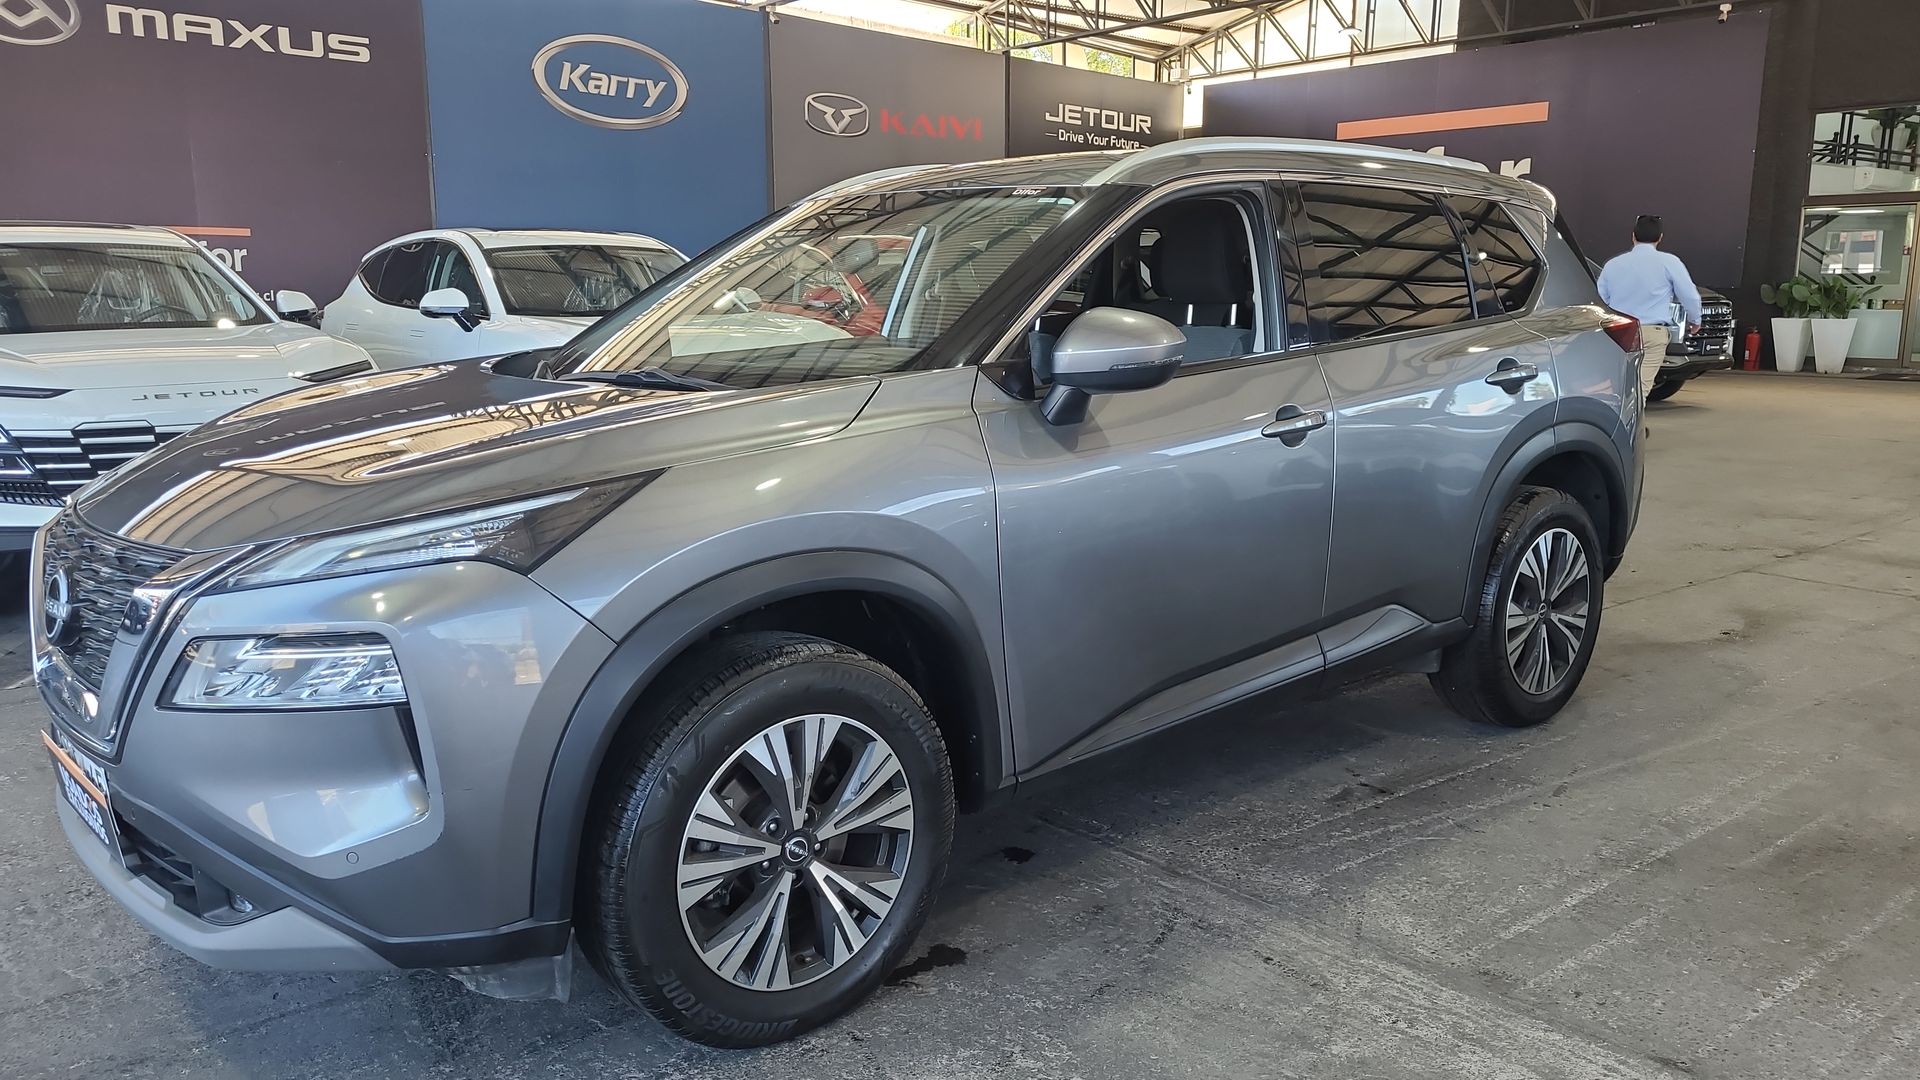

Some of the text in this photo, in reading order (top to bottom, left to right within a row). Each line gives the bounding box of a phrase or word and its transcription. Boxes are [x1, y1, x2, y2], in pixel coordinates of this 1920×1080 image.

[105, 4, 371, 63] MAXUS
[559, 61, 667, 108] Karry
[1045, 103, 1152, 135] JETOUR
[1058, 129, 1140, 150] Drive Your Future
[131, 388, 259, 401] JETOUR
[654, 968, 800, 1039] BRIDGESTONE
